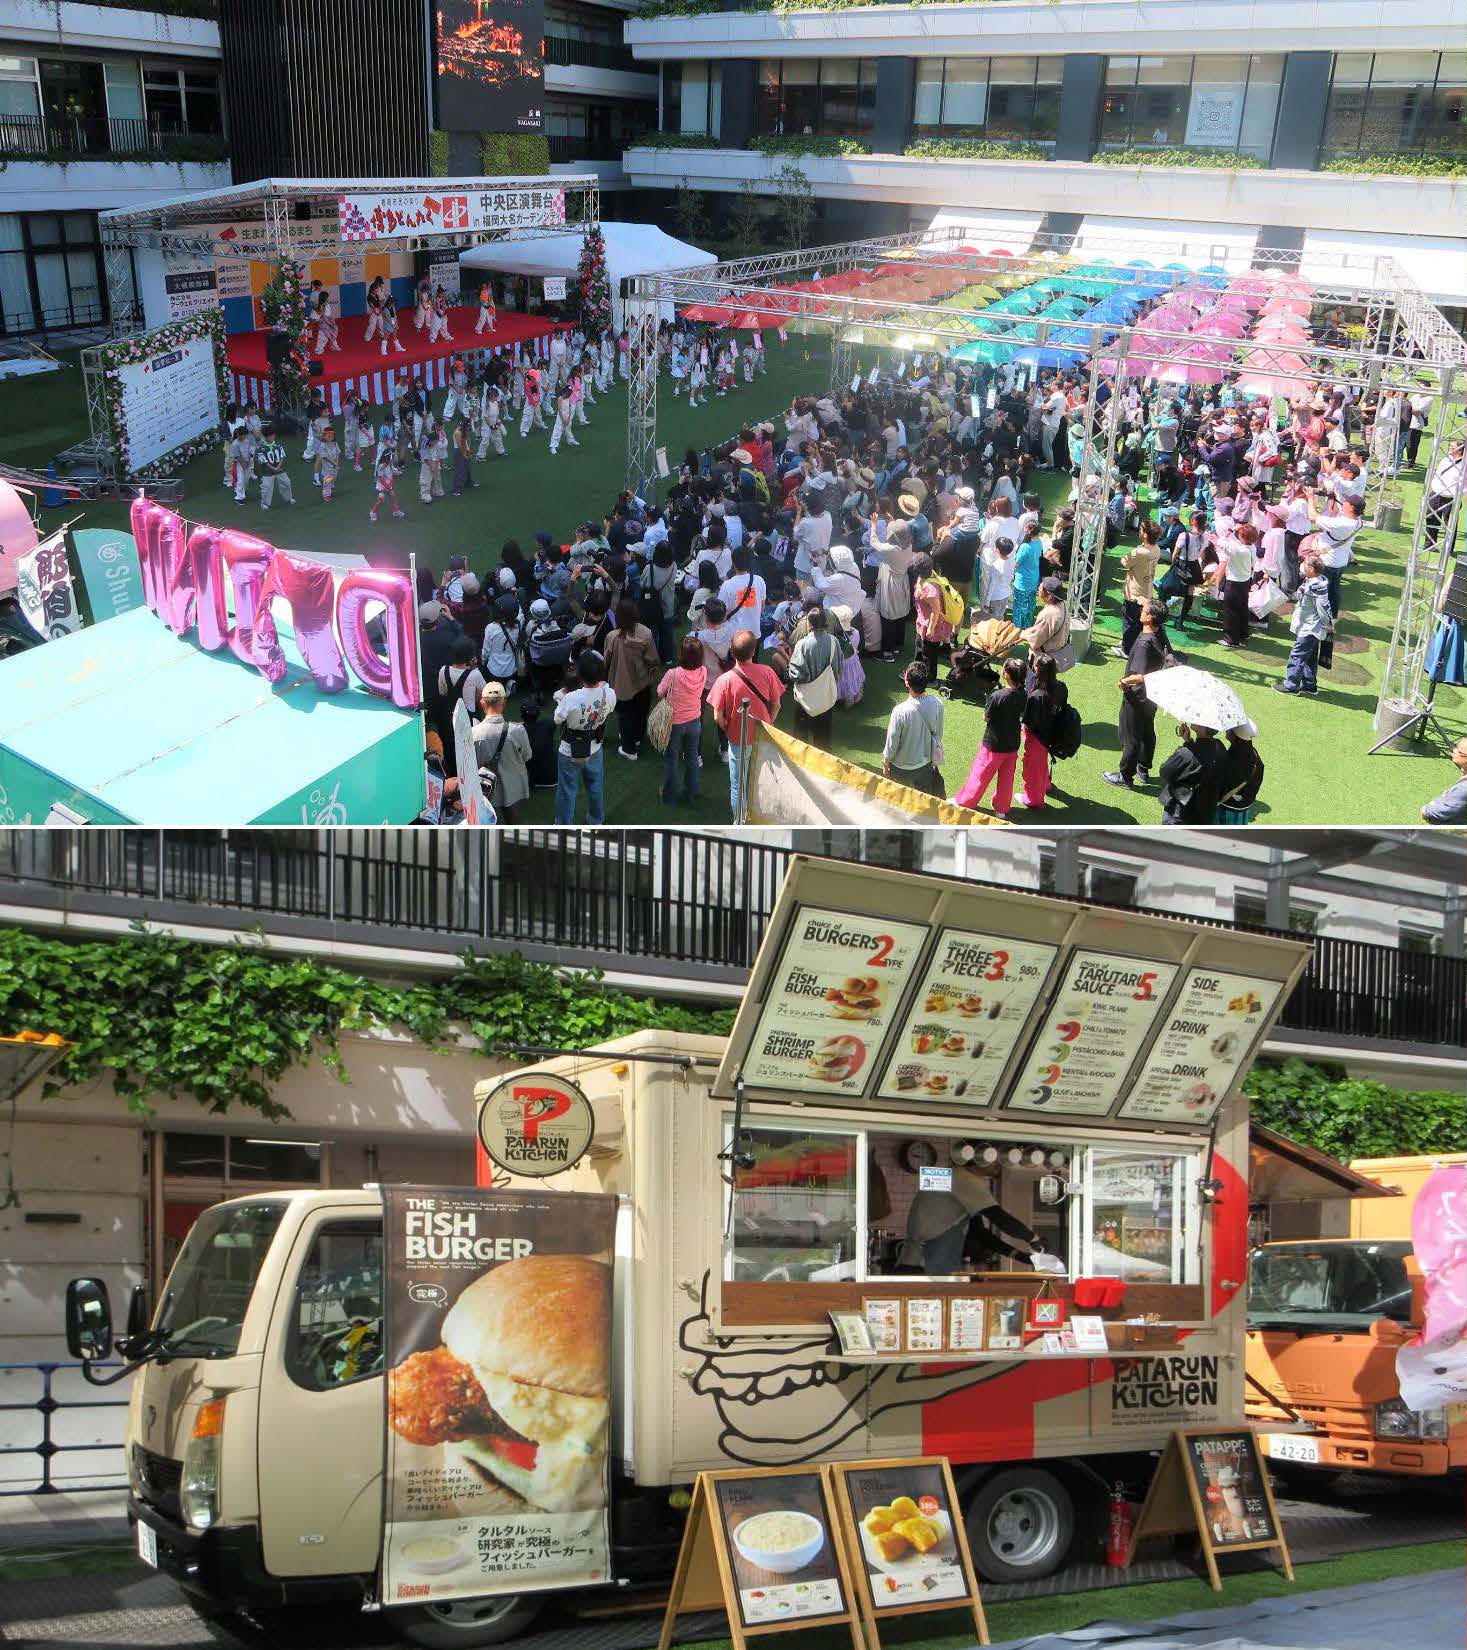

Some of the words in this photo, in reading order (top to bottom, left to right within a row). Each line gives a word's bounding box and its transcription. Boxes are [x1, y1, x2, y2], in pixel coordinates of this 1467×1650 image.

[480, 192, 554, 212] 中央区演舞台
[483, 209, 562, 227] 福岡大名ガーデンシティ
[808, 919, 832, 929] choice
[803, 925, 880, 950] BURGERS
[866, 934, 896, 968] 2
[946, 946, 993, 964] THREE
[984, 950, 1009, 981] 3
[788, 971, 818, 986] FISH
[1132, 972, 1159, 1000] 5
[1191, 977, 1221, 992] SIDE
[784, 982, 829, 998] BURGE
[1072, 978, 1116, 996] SAUCE
[1170, 1019, 1210, 1035] DRINK
[766, 1035, 816, 1050] SHRIMP
[762, 1045, 814, 1060] BURGER
[1171, 1064, 1209, 1079] DRINK
[505, 1136, 569, 1150] PATARUN
[505, 1148, 568, 1161] KITCHEN
[405, 1198, 436, 1210] THE
[406, 1211, 476, 1236] FISH
[405, 1236, 534, 1260] BURGER
[1112, 1356, 1218, 1384] PATARUN
[1112, 1380, 1218, 1410] KITCHEN
[478, 1524, 552, 1538] タルタルソース
[478, 1536, 560, 1550] 研究家が究極の
